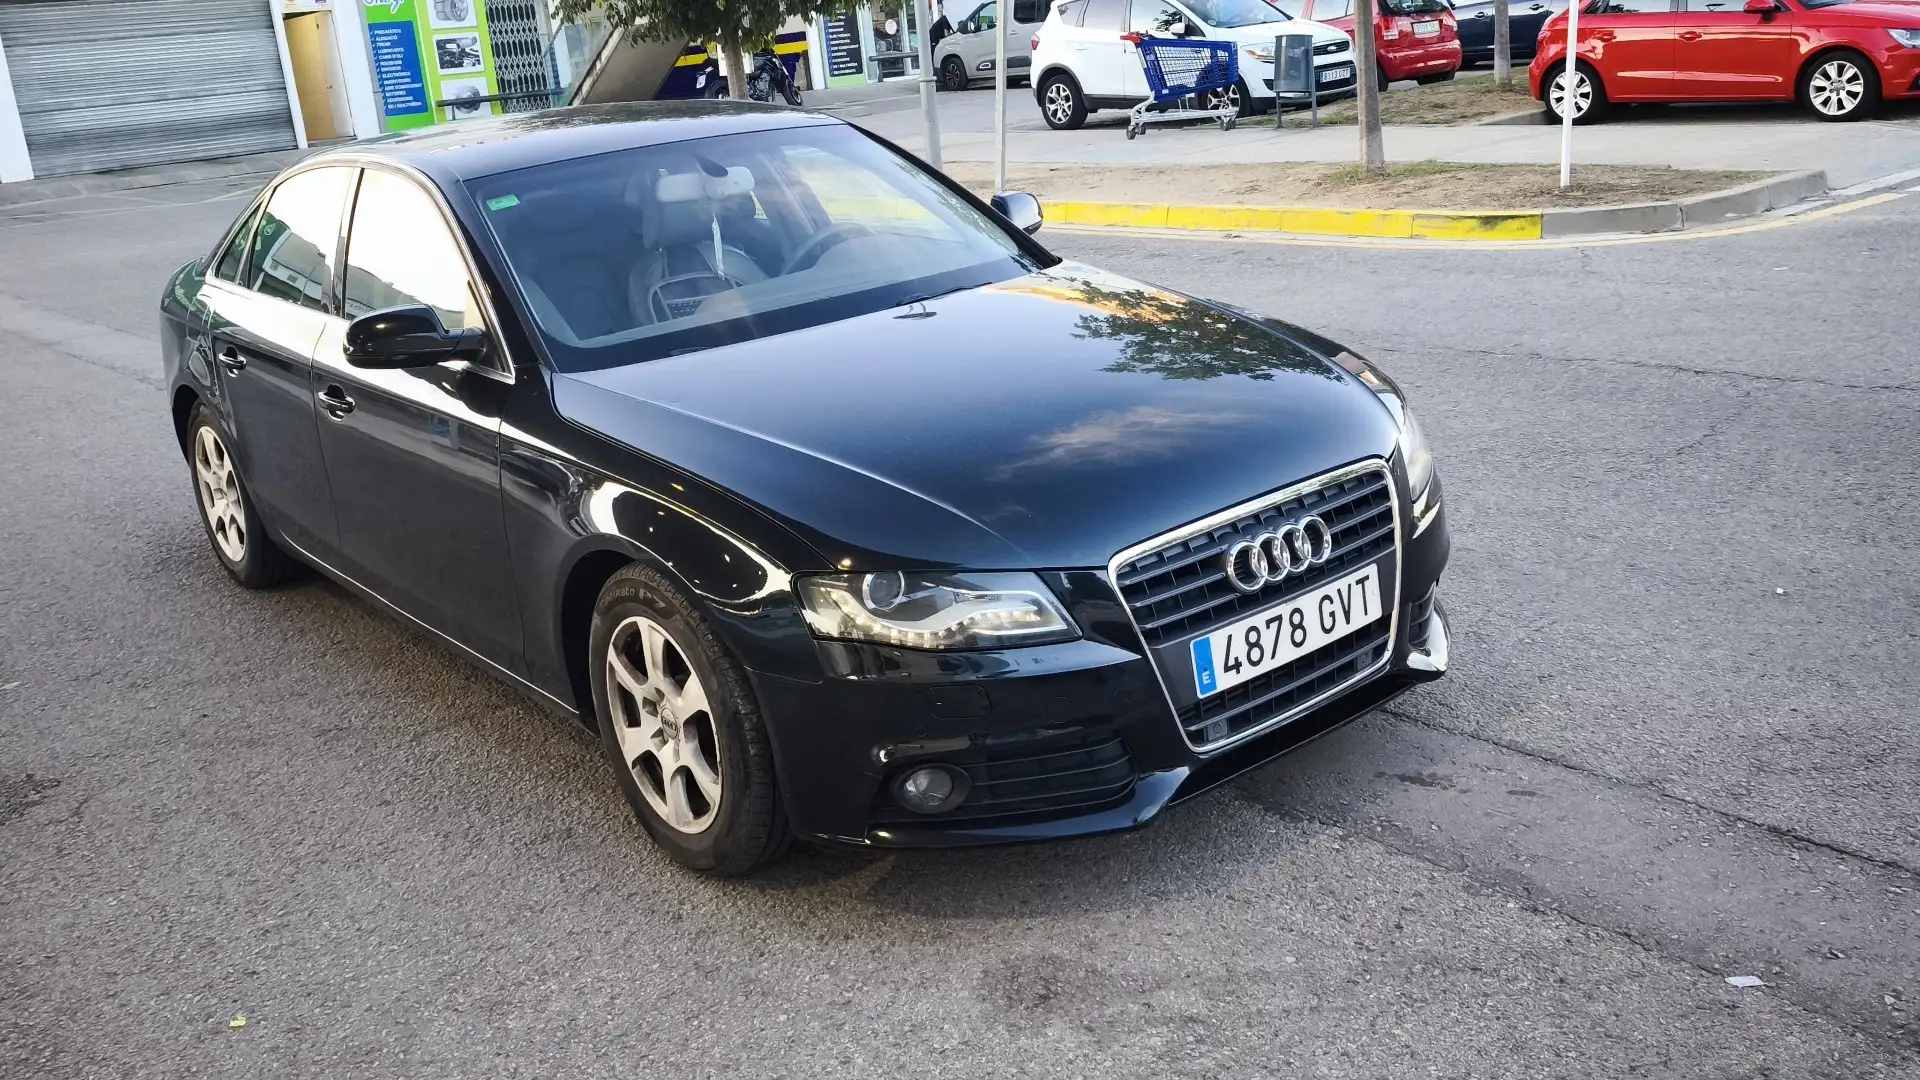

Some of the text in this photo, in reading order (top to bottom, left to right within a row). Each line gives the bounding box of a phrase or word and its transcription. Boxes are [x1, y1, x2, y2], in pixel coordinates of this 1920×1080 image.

[1223, 574, 1371, 676] 4878 GVT
[1201, 671, 1212, 685] E
